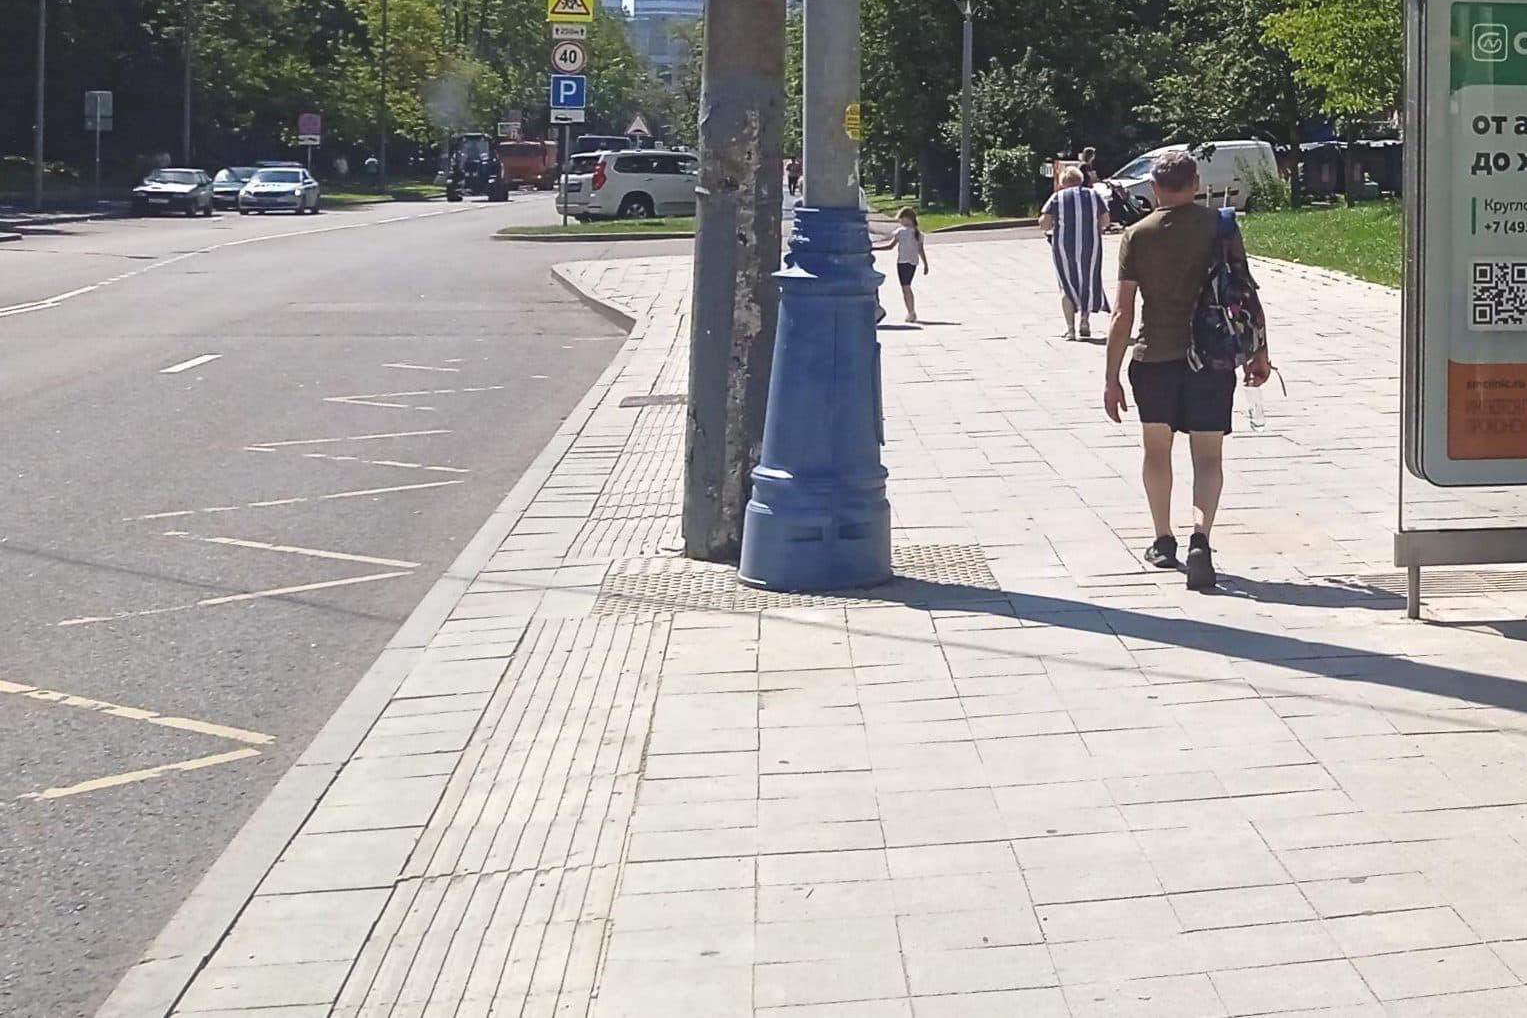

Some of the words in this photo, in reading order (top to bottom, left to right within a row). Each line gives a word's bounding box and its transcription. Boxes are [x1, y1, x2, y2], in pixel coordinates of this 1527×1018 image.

[559, 49, 577, 64] 40
[559, 81, 576, 103] P
[1472, 115, 1507, 135] от
[1471, 152, 1511, 175] до
[1484, 221, 1500, 233] +7
